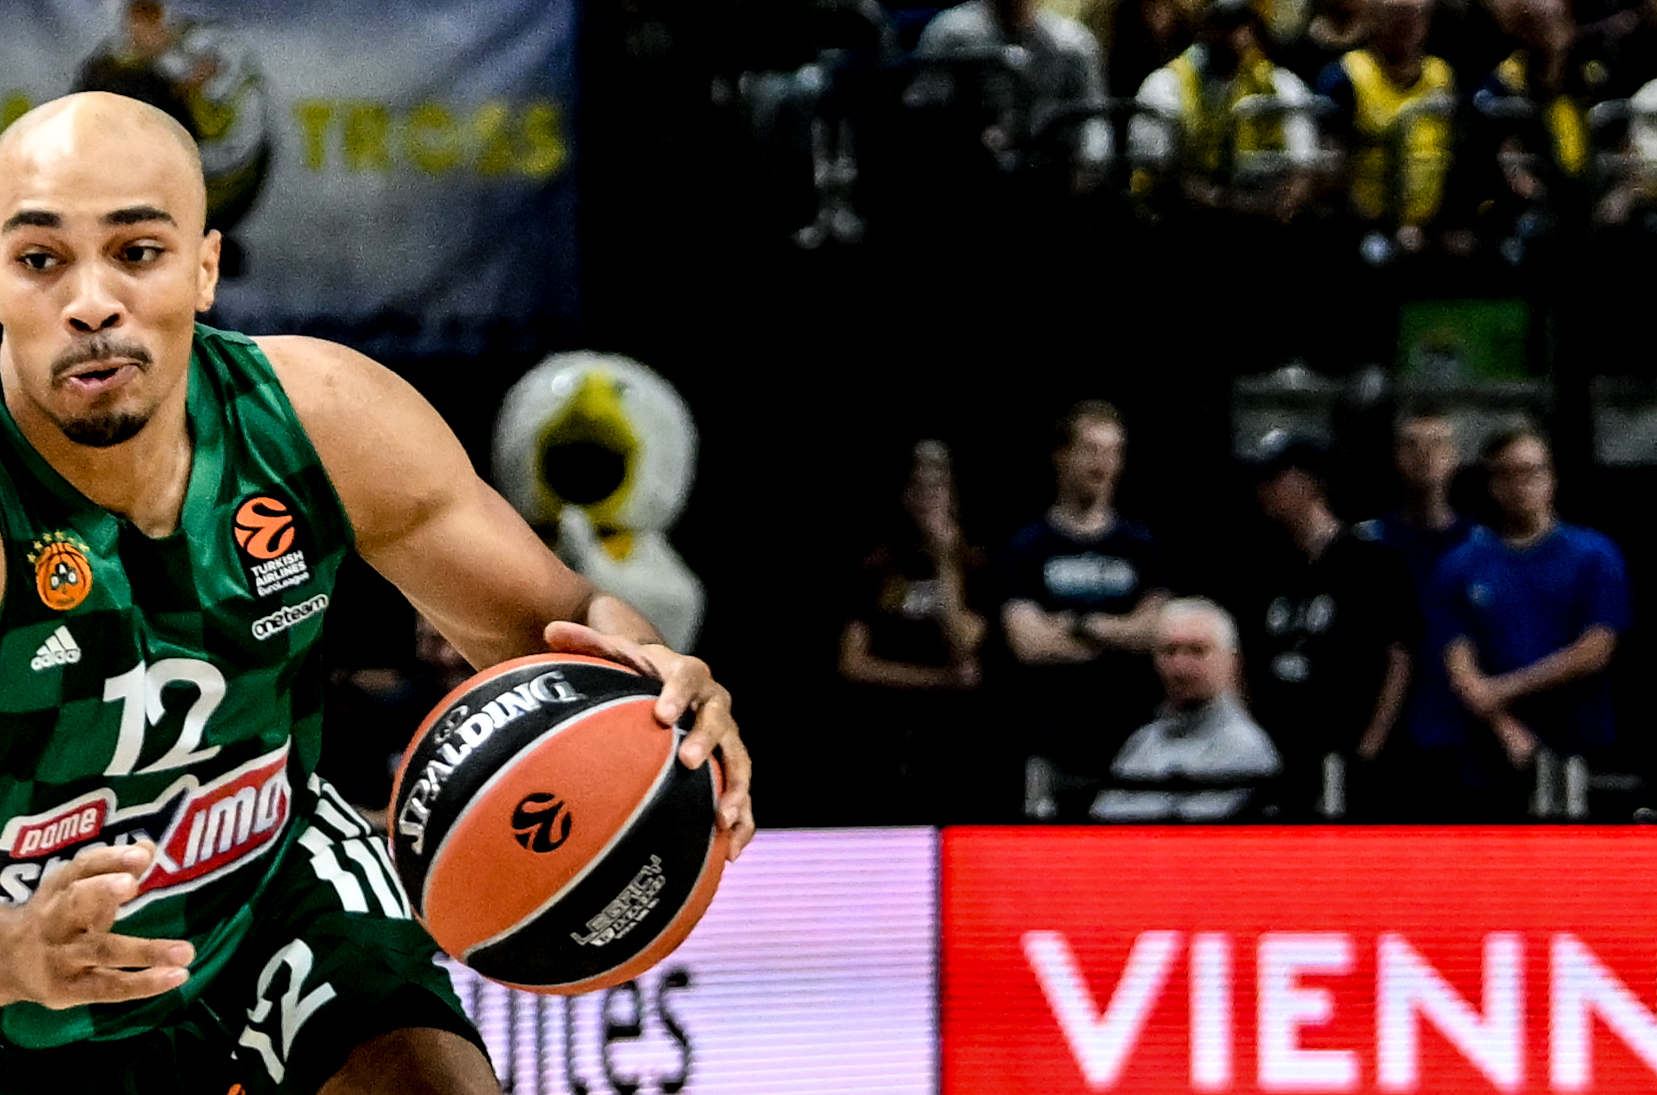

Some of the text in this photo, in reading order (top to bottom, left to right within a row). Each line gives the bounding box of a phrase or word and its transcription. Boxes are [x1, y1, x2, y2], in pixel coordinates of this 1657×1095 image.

[250, 550, 305, 576] TURKISH
[255, 561, 308, 587] AIRLINES
[102, 657, 227, 777] 12
[398, 670, 589, 856] SPALDING
[1020, 929, 1657, 1095] VIENN
